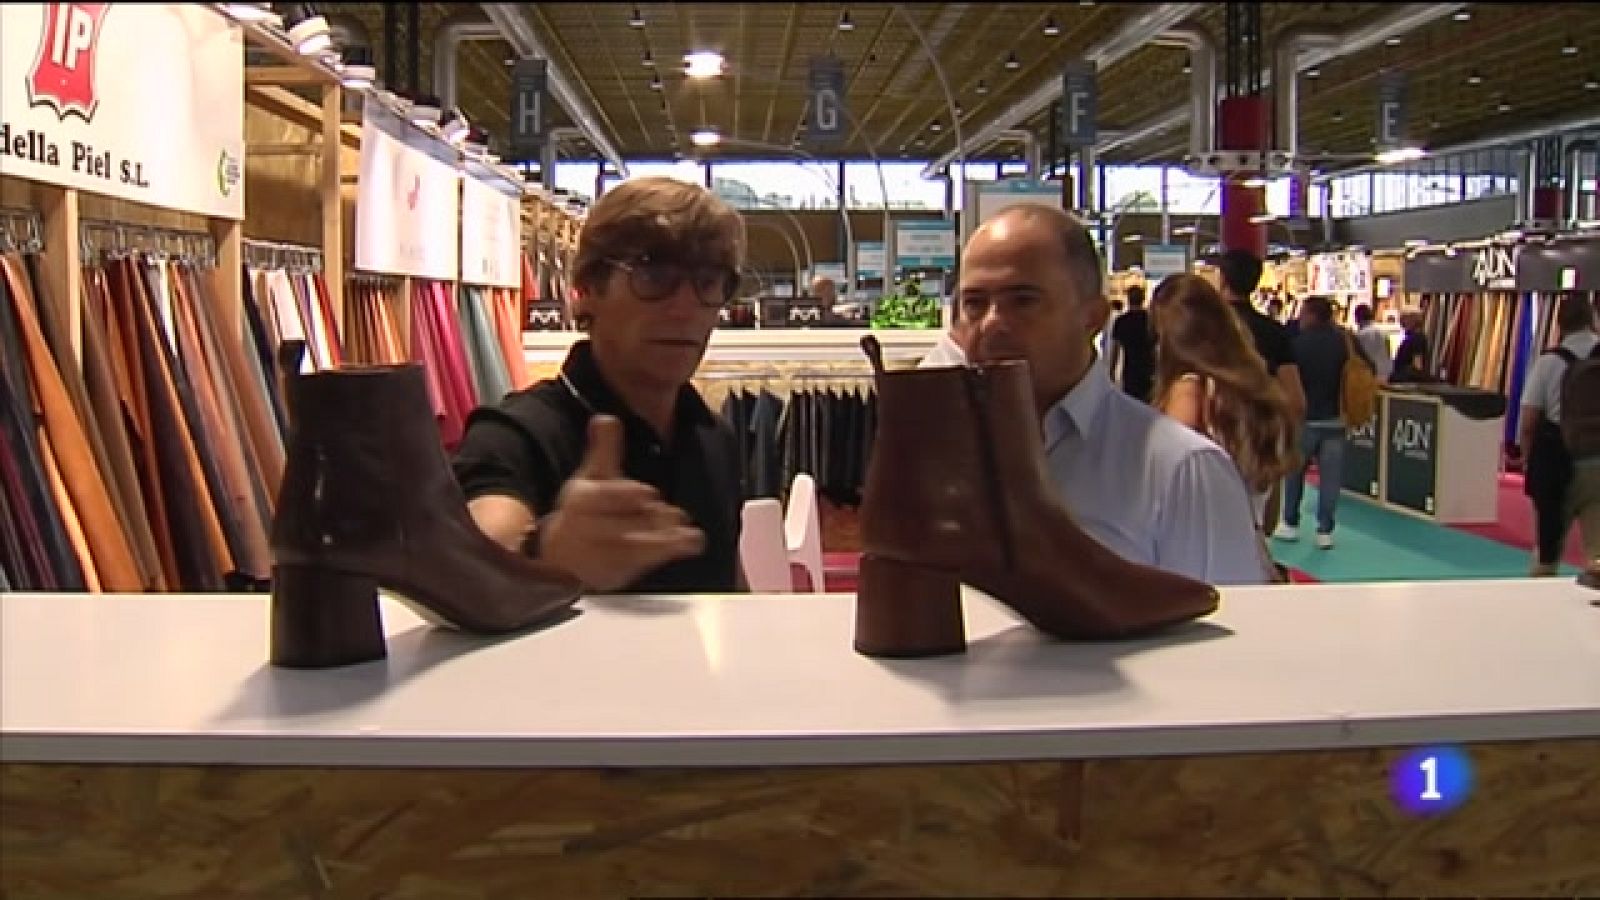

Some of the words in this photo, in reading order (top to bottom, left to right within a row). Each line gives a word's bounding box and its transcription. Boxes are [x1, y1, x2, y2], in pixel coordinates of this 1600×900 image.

[519, 91, 541, 133] H
[816, 89, 836, 131] G
[1072, 92, 1089, 133] F
[1382, 102, 1400, 144] E
[72, 140, 111, 180] Piel
